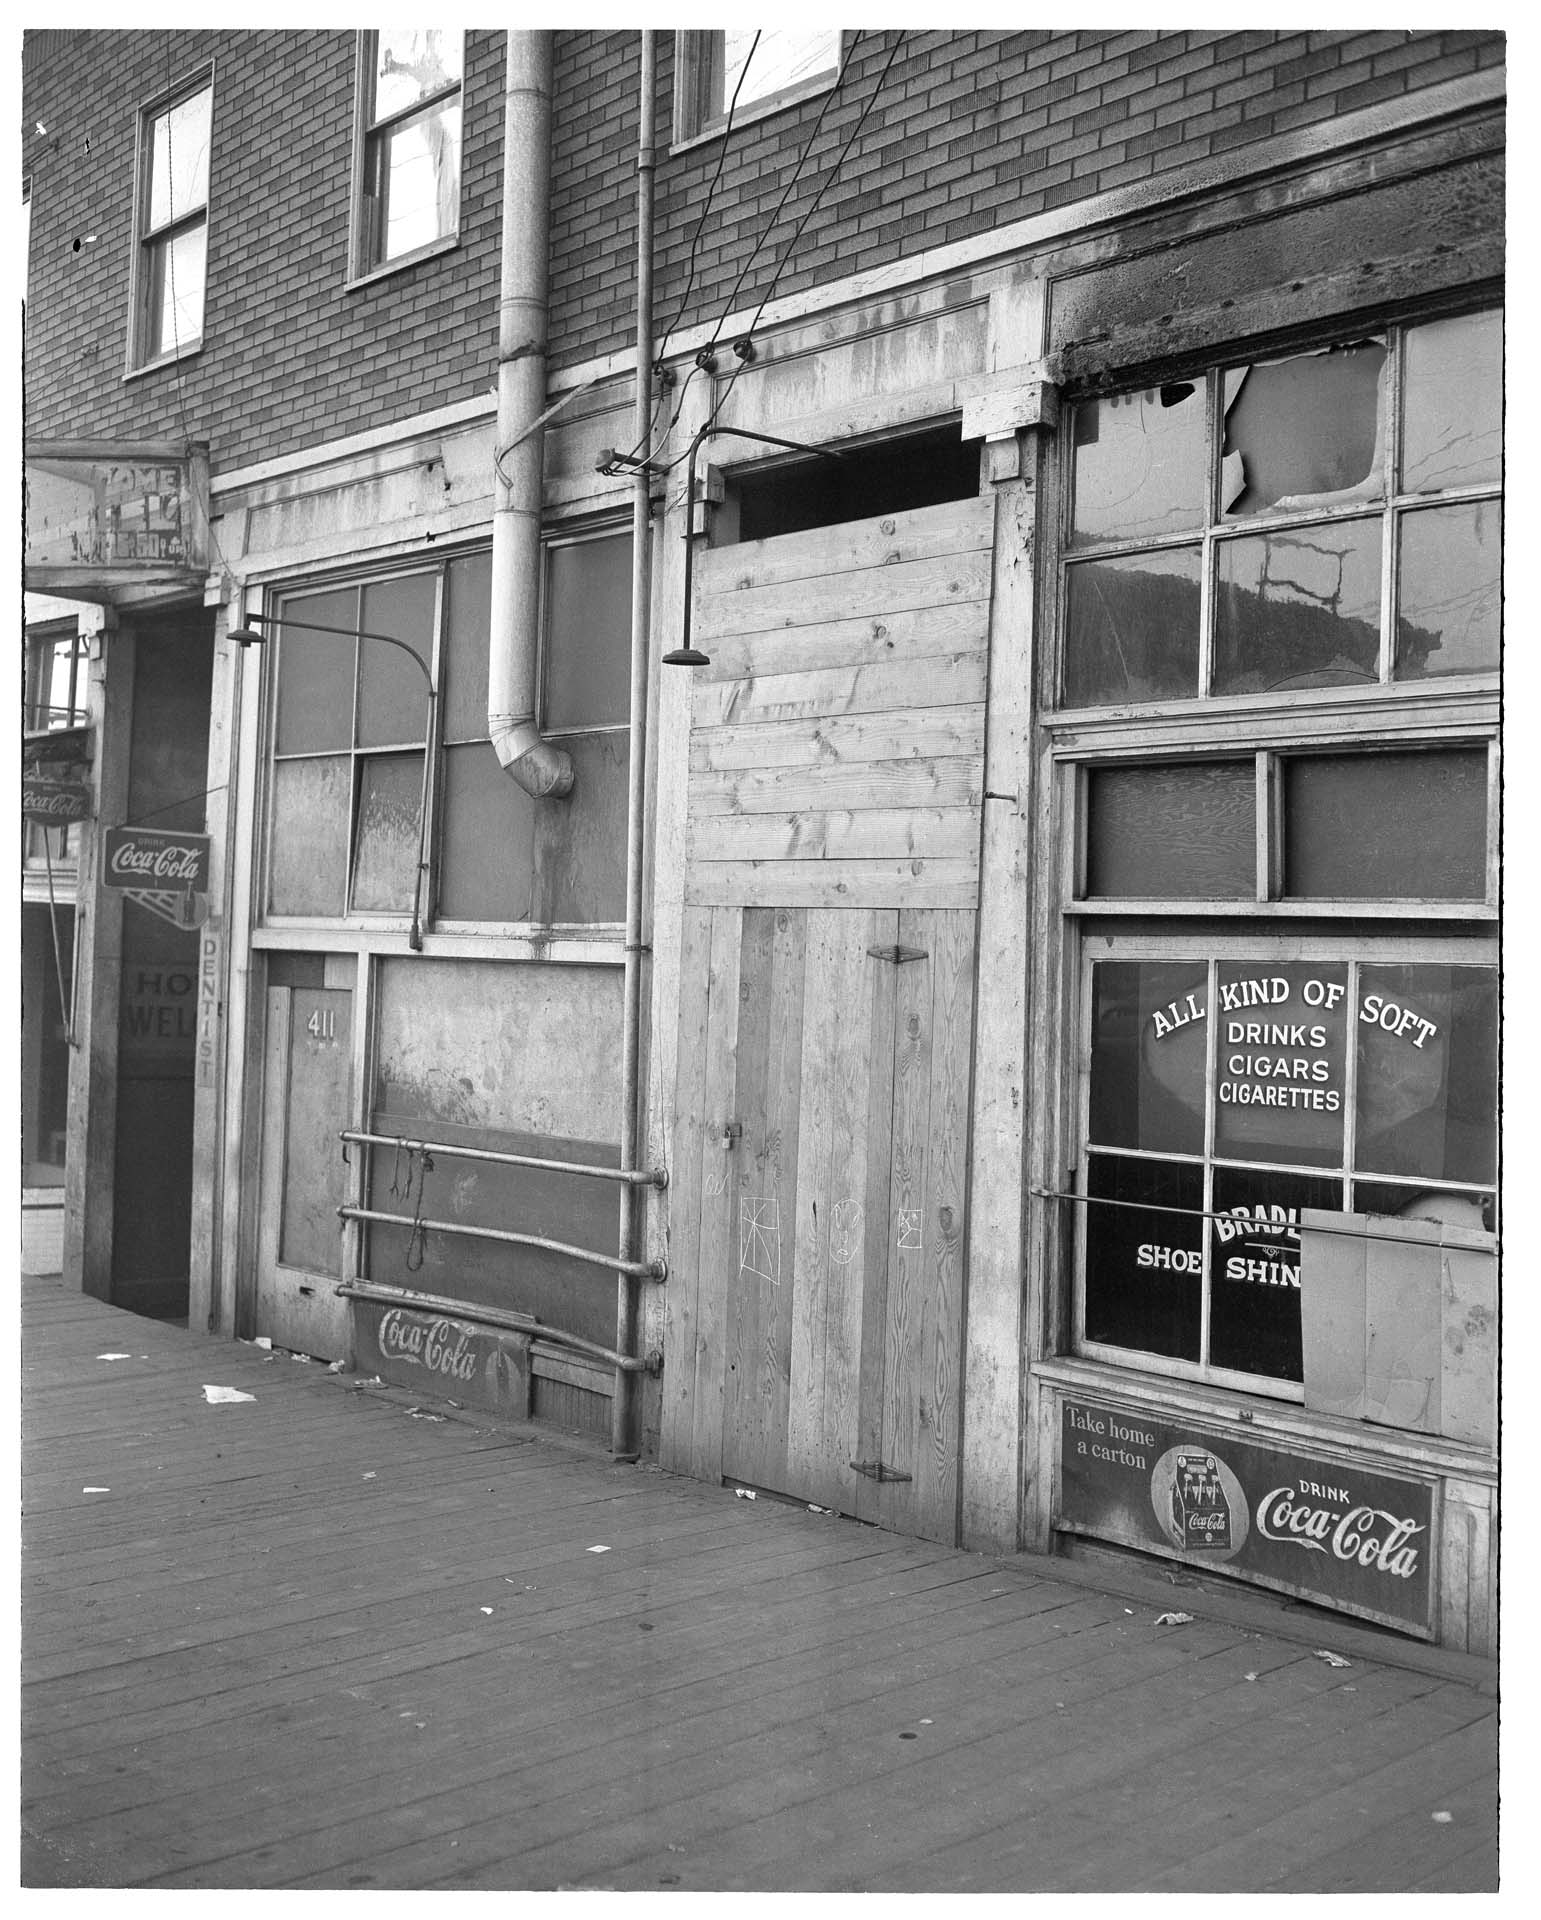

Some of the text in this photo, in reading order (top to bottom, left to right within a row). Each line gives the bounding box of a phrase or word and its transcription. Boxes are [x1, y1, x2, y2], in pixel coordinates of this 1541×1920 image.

[112, 842, 203, 879] Coca-Cola
[137, 971, 198, 996] HO
[201, 940, 217, 1078] DENTIST
[308, 1009, 334, 1038] 411
[1152, 977, 1437, 1048] ALL KIND OF SOFT
[1228, 1022, 1327, 1047] DRINKS
[1229, 1055, 1329, 1082] CIGARS
[1219, 1082, 1340, 1111] CIGARETTES
[1137, 1244, 1301, 1288] SHOE SHIN
[378, 1308, 478, 1381] Coca-Cola
[1066, 1406, 1155, 1447] Take home
[1077, 1441, 1146, 1470] a carton
[1299, 1480, 1350, 1504] DRINK
[1256, 1487, 1426, 1579] Coca-Cola
